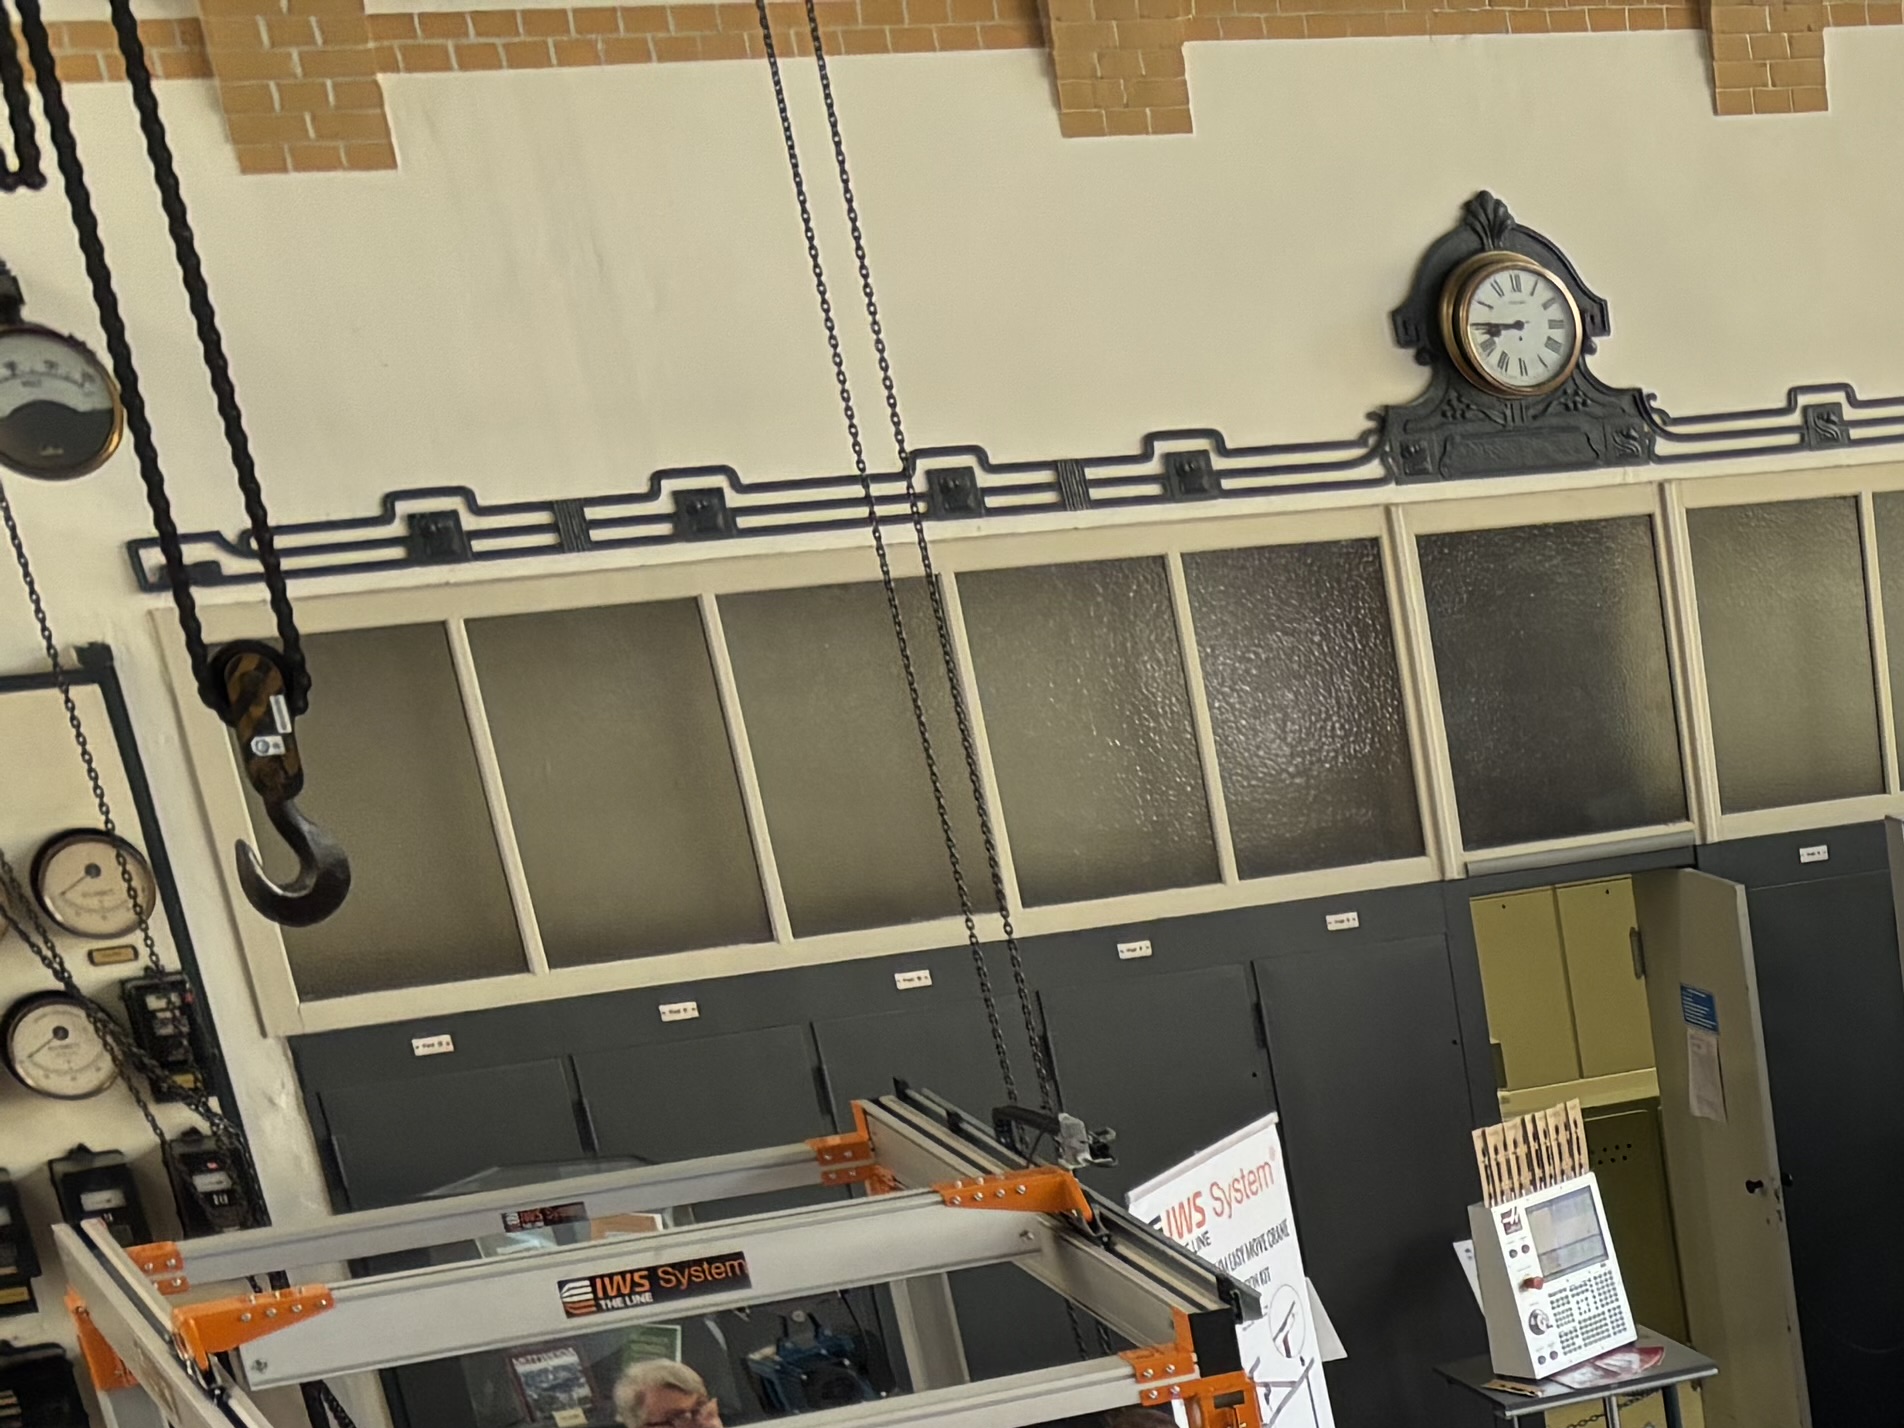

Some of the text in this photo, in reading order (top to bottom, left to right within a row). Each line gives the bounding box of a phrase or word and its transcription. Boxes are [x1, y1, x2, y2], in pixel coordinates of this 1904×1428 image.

[1166, 1191, 1206, 1240] IWS
[595, 1257, 747, 1298] IWS System
[600, 1291, 654, 1310] THE LINE
